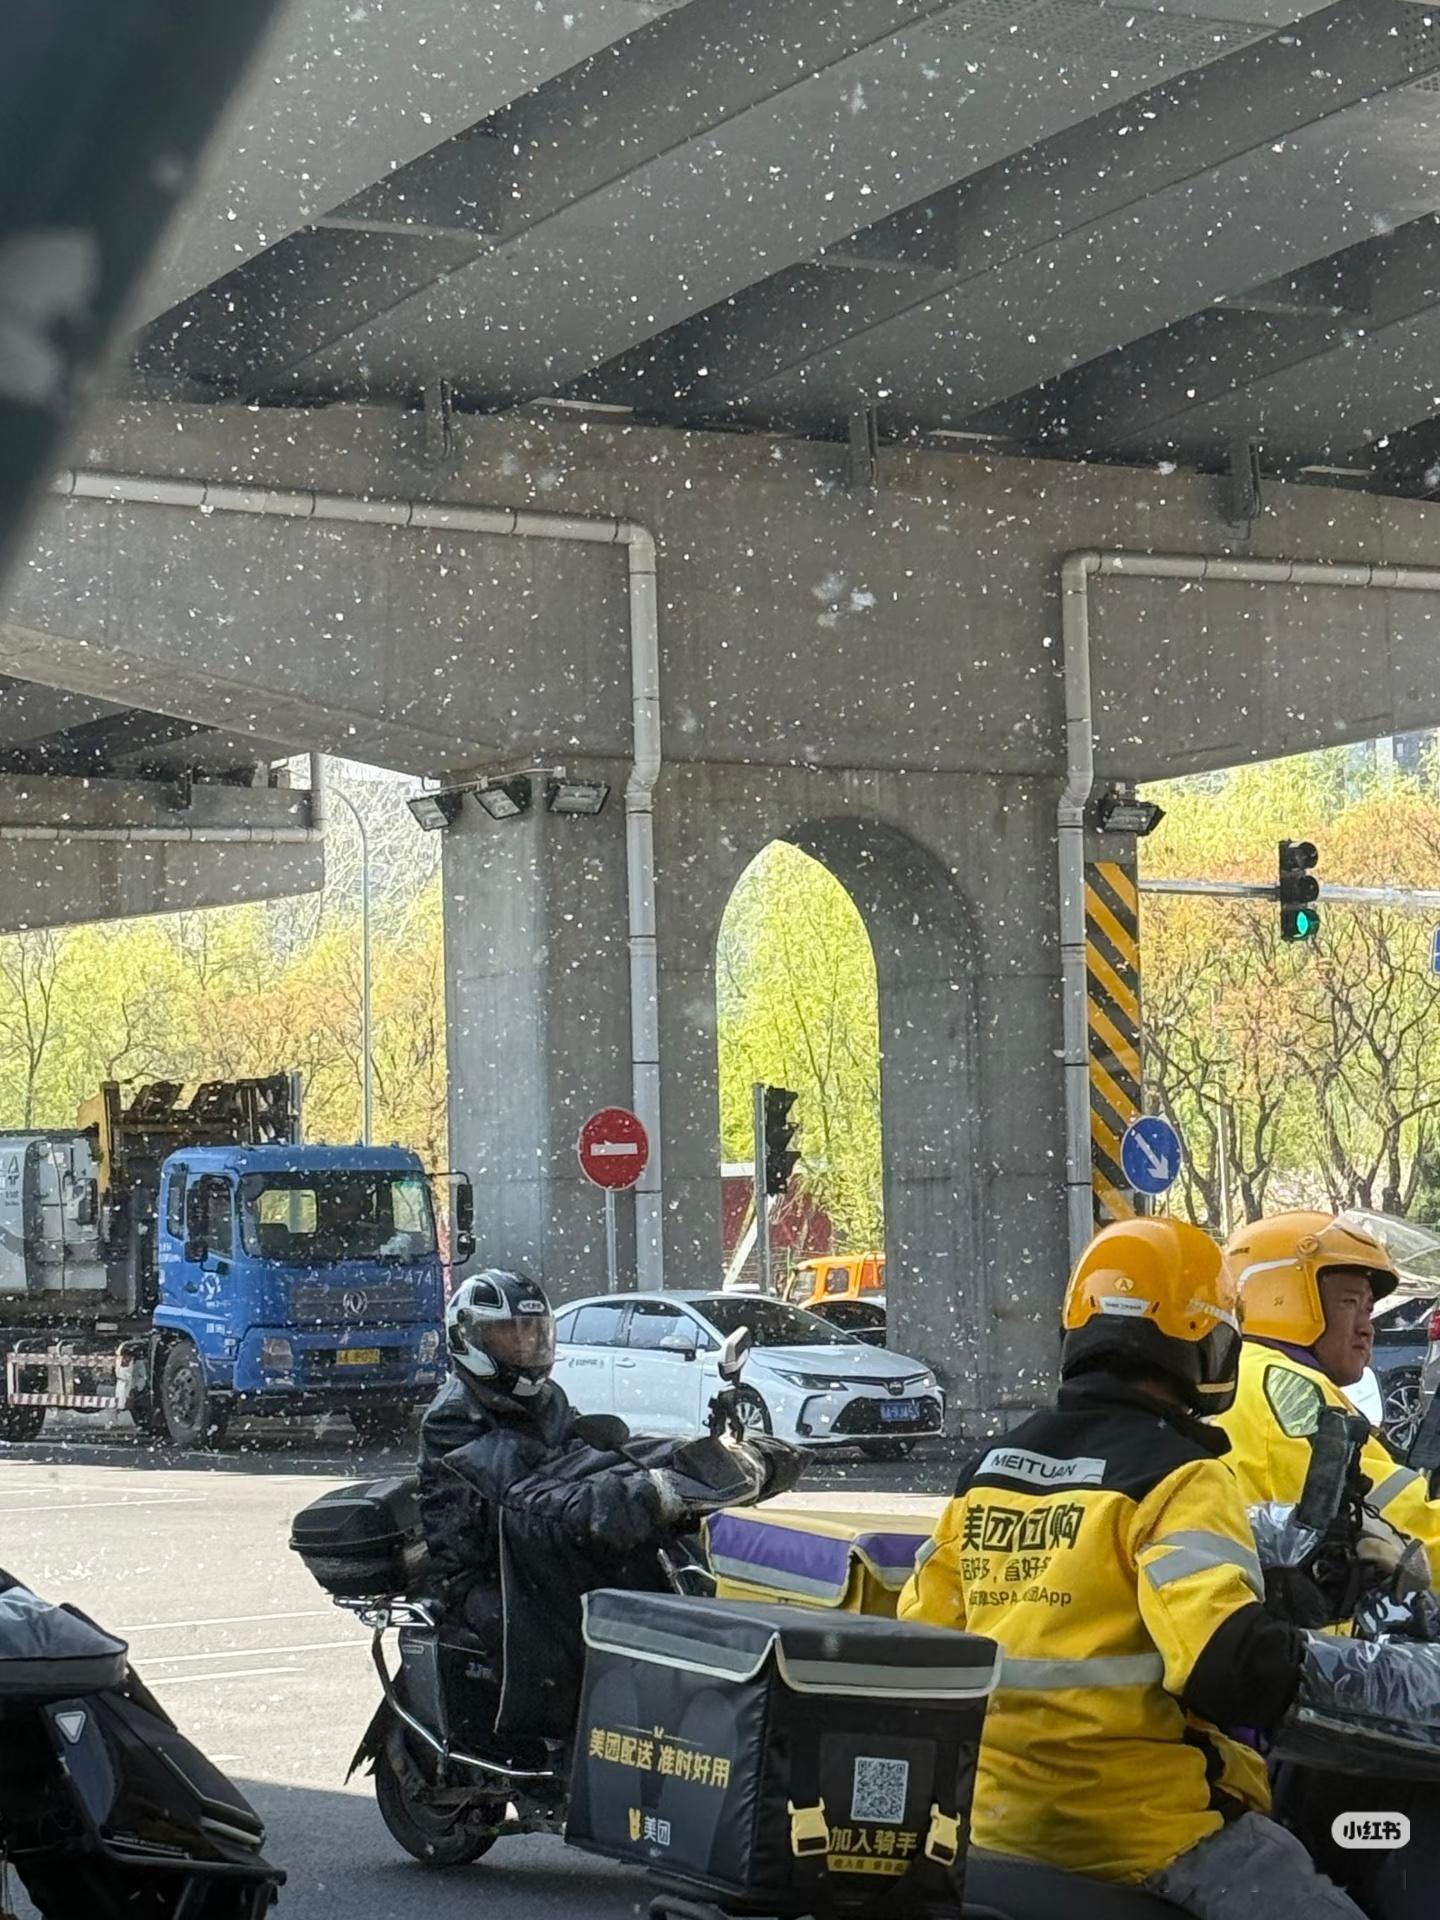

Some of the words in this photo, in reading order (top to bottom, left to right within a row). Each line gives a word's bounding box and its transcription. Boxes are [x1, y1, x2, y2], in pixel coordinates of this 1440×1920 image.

[992, 1454, 1077, 1479] MEITUAN
[961, 1503, 1086, 1552] 美团团购
[589, 1727, 654, 1771] 美团配送
[657, 1744, 731, 1789] 准时好用
[643, 1815, 671, 1846] 美团
[829, 1826, 918, 1857] 加入骑手
